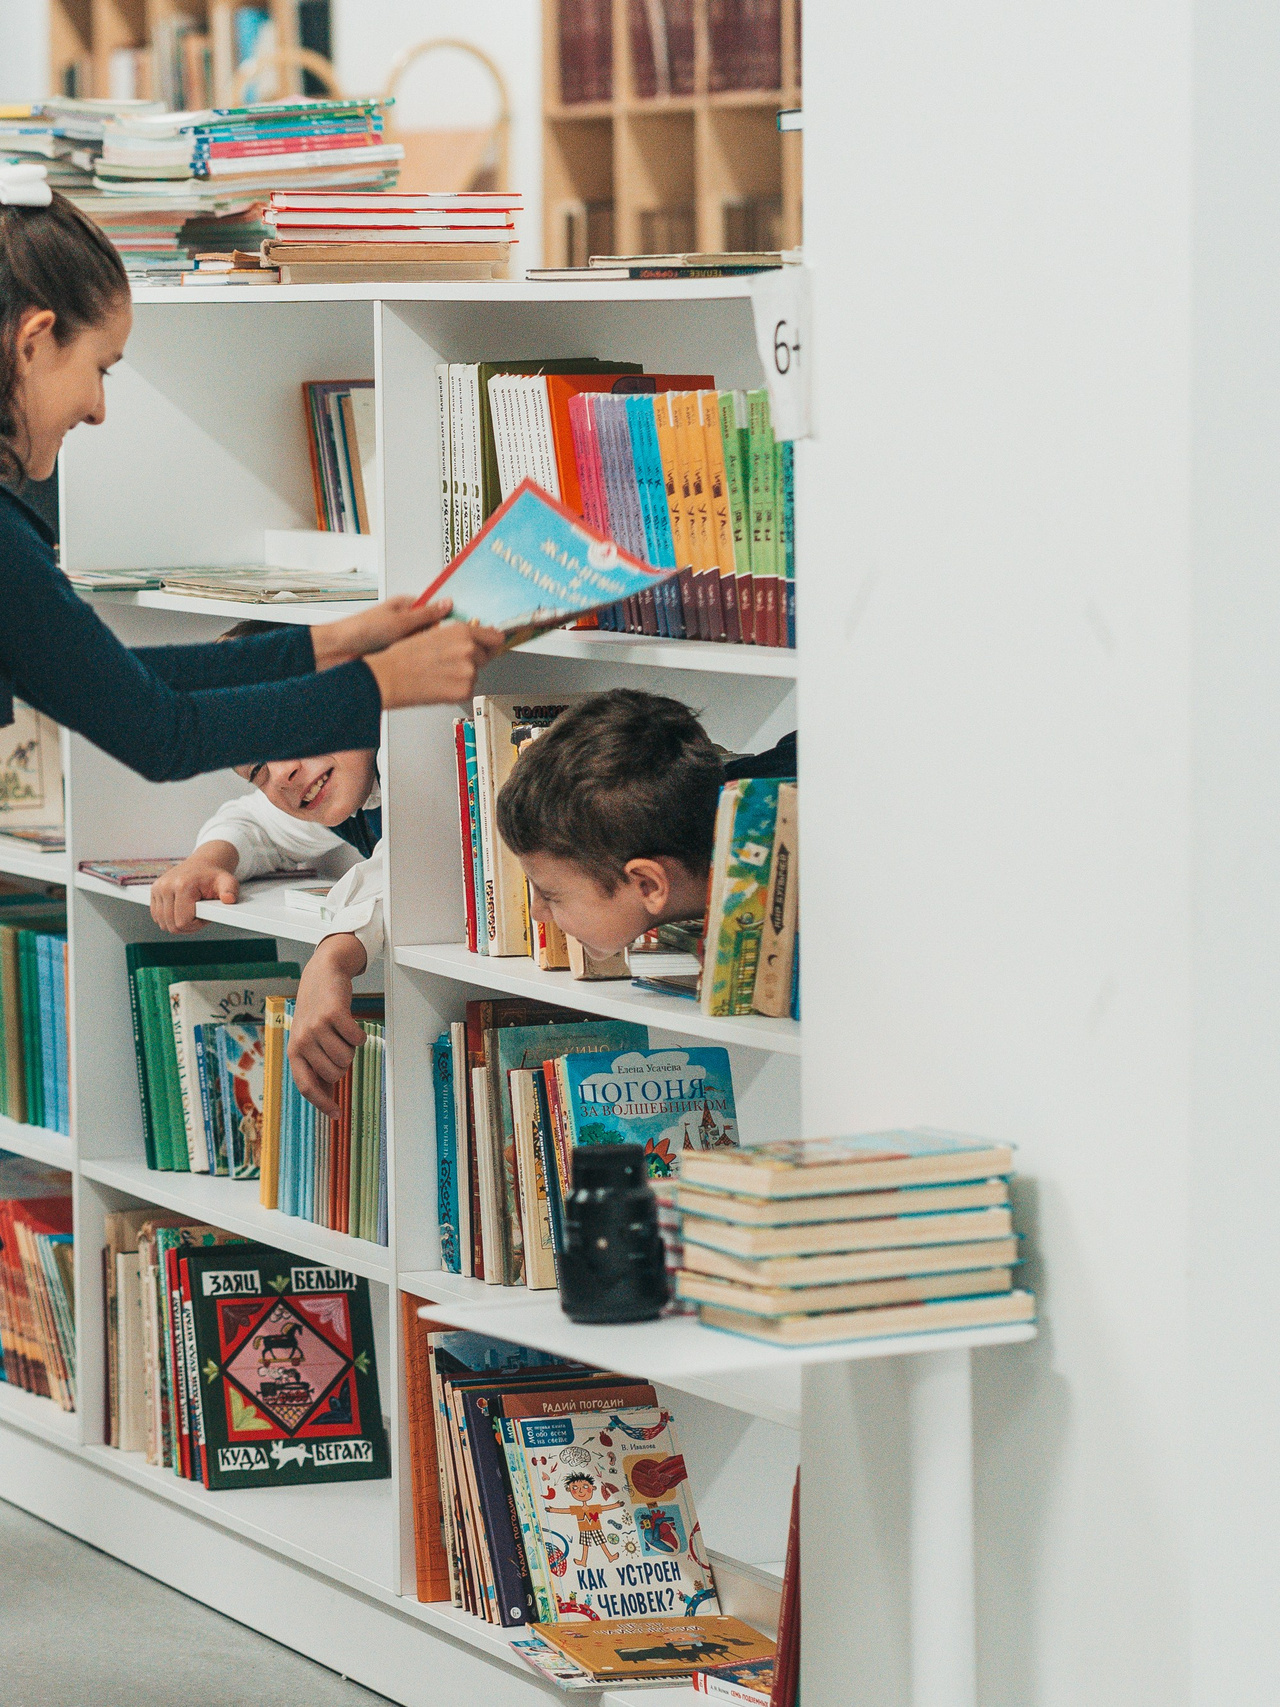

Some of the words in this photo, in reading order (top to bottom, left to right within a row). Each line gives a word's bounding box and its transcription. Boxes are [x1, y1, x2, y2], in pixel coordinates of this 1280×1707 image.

[773, 319, 802, 376] 6+
[483, 879, 497, 941] СКАЗКИ
[617, 1065, 644, 1074] Елена
[645, 1063, 682, 1074] Усачёва
[578, 1077, 705, 1104] ПОГОНЯ
[580, 1104, 598, 1118] ЗА
[602, 1099, 728, 1117] ВОЛШЕБНИКОМ
[209, 1273, 260, 1295] ЗАЯЦ
[542, 1400, 576, 1413] РАДИЙ
[579, 1398, 624, 1410] ПОГОДИН
[221, 1449, 266, 1471] КУДА
[315, 1442, 371, 1461] БЕГАЛ?
[507, 1494, 520, 1539] ПОГОДИН
[517, 1543, 527, 1578] РАДИЙ
[577, 1567, 608, 1591] КАК
[616, 1560, 682, 1587] УСТРОЕН
[512, 1608, 520, 1617] 6+
[597, 1587, 674, 1618] ЧЕЛОВЕК?
